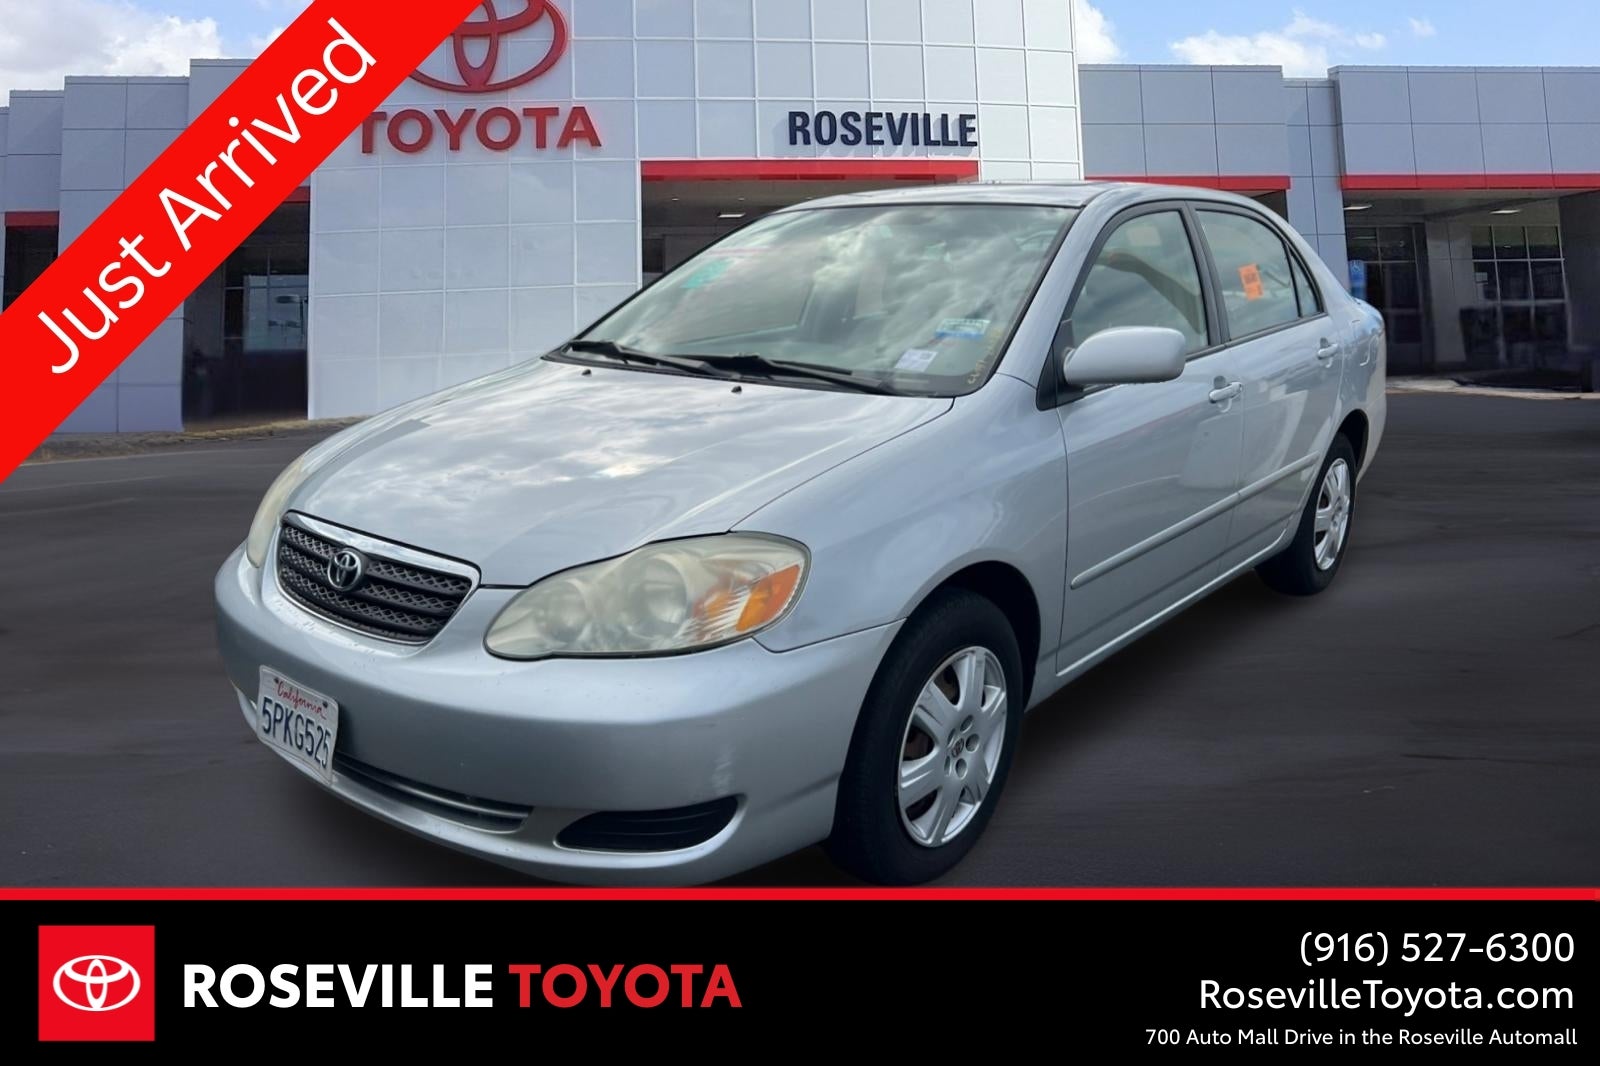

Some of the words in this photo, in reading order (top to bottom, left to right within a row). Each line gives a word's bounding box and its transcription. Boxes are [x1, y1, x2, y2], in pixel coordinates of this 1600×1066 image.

[361, 106, 602, 154] TOYOTA
[788, 110, 978, 147] ROSEVILLE
[275, 680, 327, 720] California
[261, 696, 332, 769] 5PKG525
